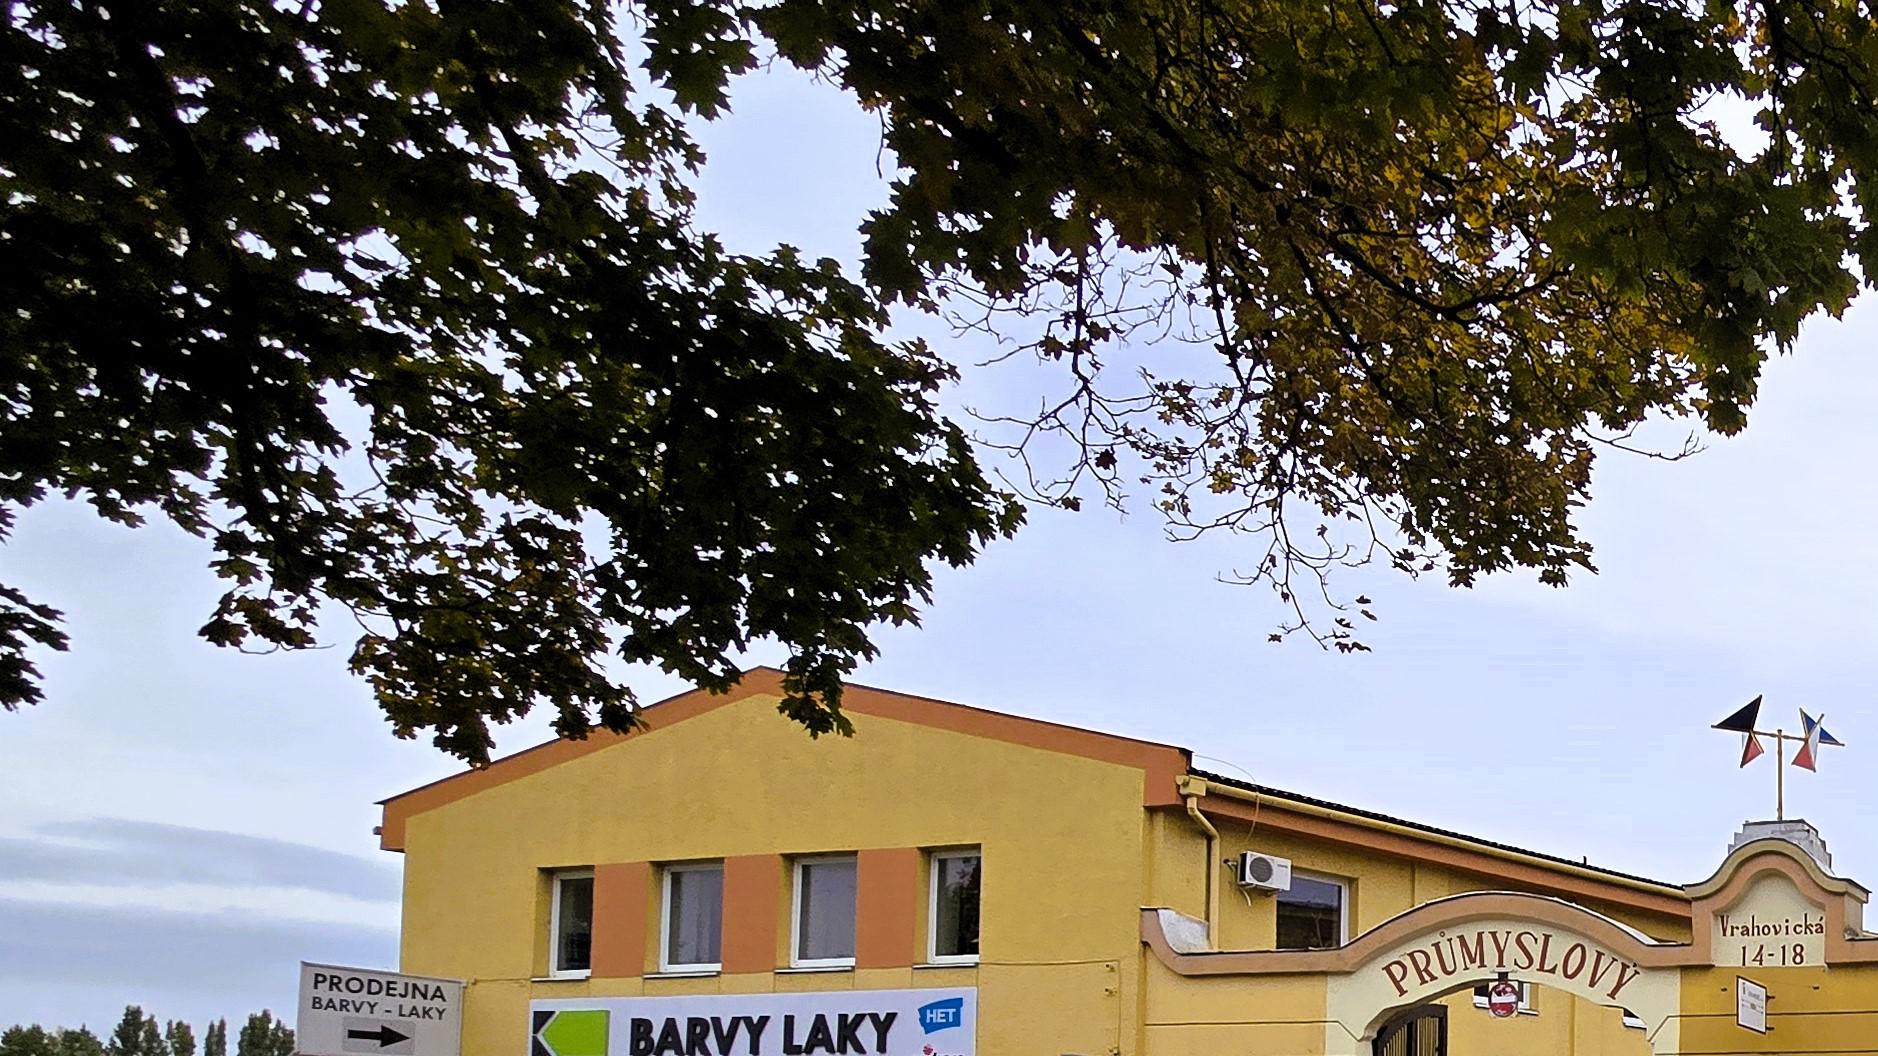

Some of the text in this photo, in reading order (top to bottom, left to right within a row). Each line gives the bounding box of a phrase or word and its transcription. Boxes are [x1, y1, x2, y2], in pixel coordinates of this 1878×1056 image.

[1720, 913, 1824, 937] Vrahovická
[1381, 930, 1641, 1000] PRŮMYSLOVÝ
[1741, 943, 1805, 966] 14-18
[312, 973, 447, 1002] PRODEJNA
[311, 996, 379, 1015] BARVY
[398, 1004, 448, 1021] LAKY
[925, 1008, 956, 1023] HET
[783, 1012, 898, 1056] LAKY
